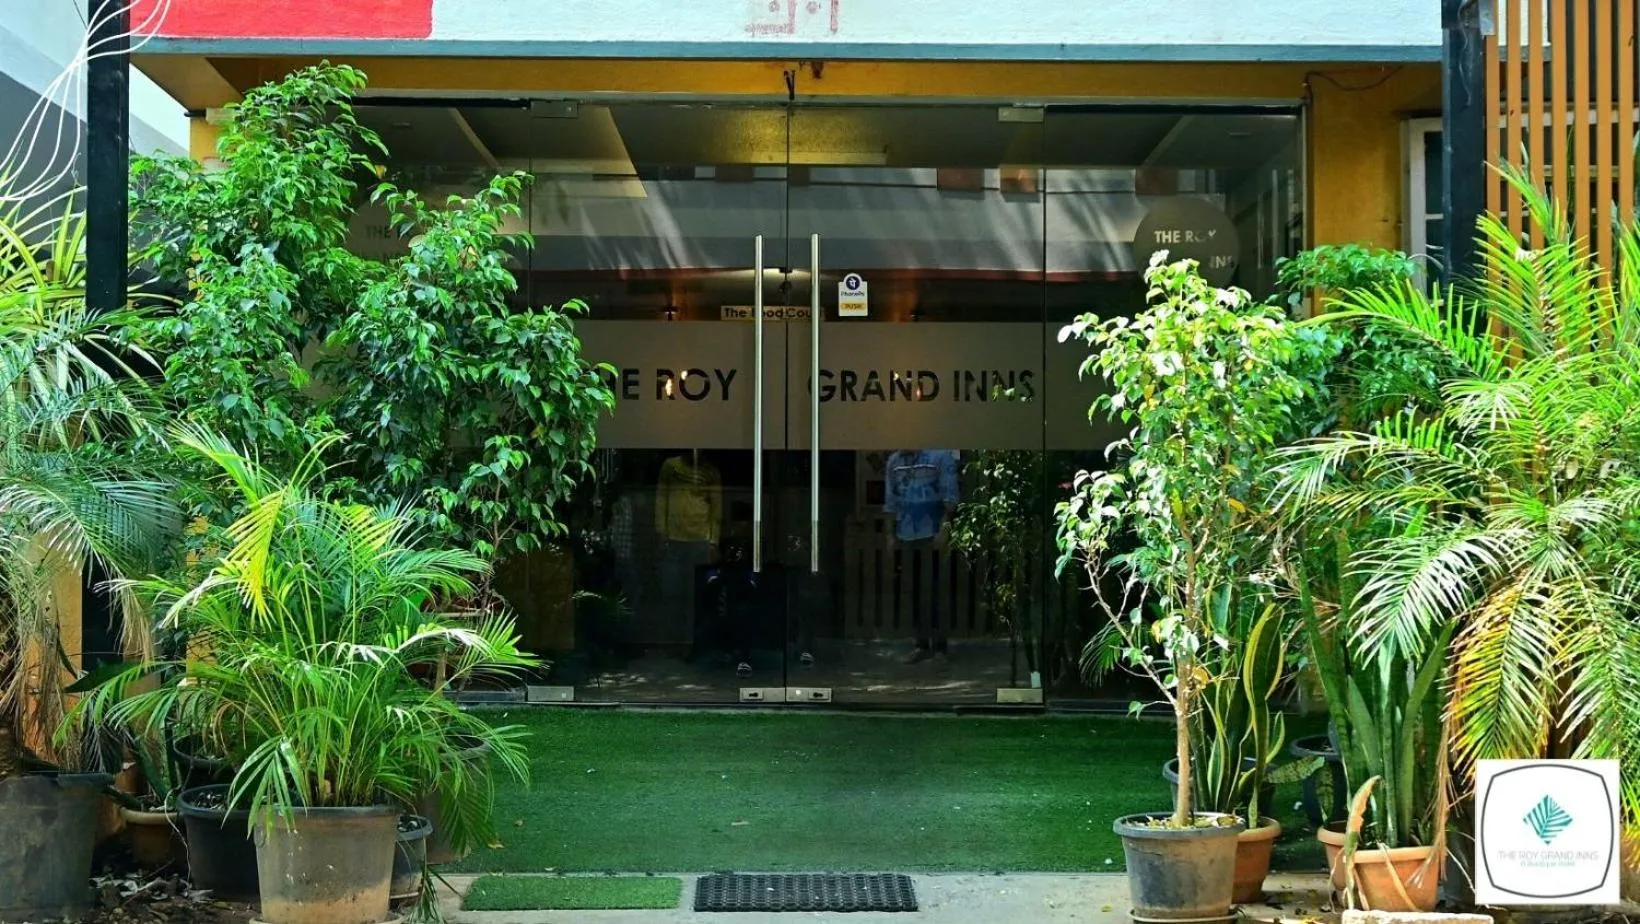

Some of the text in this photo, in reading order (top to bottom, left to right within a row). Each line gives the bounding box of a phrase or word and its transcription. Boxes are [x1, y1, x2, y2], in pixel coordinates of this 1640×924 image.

[1154, 230, 1181, 243] THE
[724, 307, 823, 318] The od Cou
[594, 368, 1036, 402] HE ROY GRAND INNS
